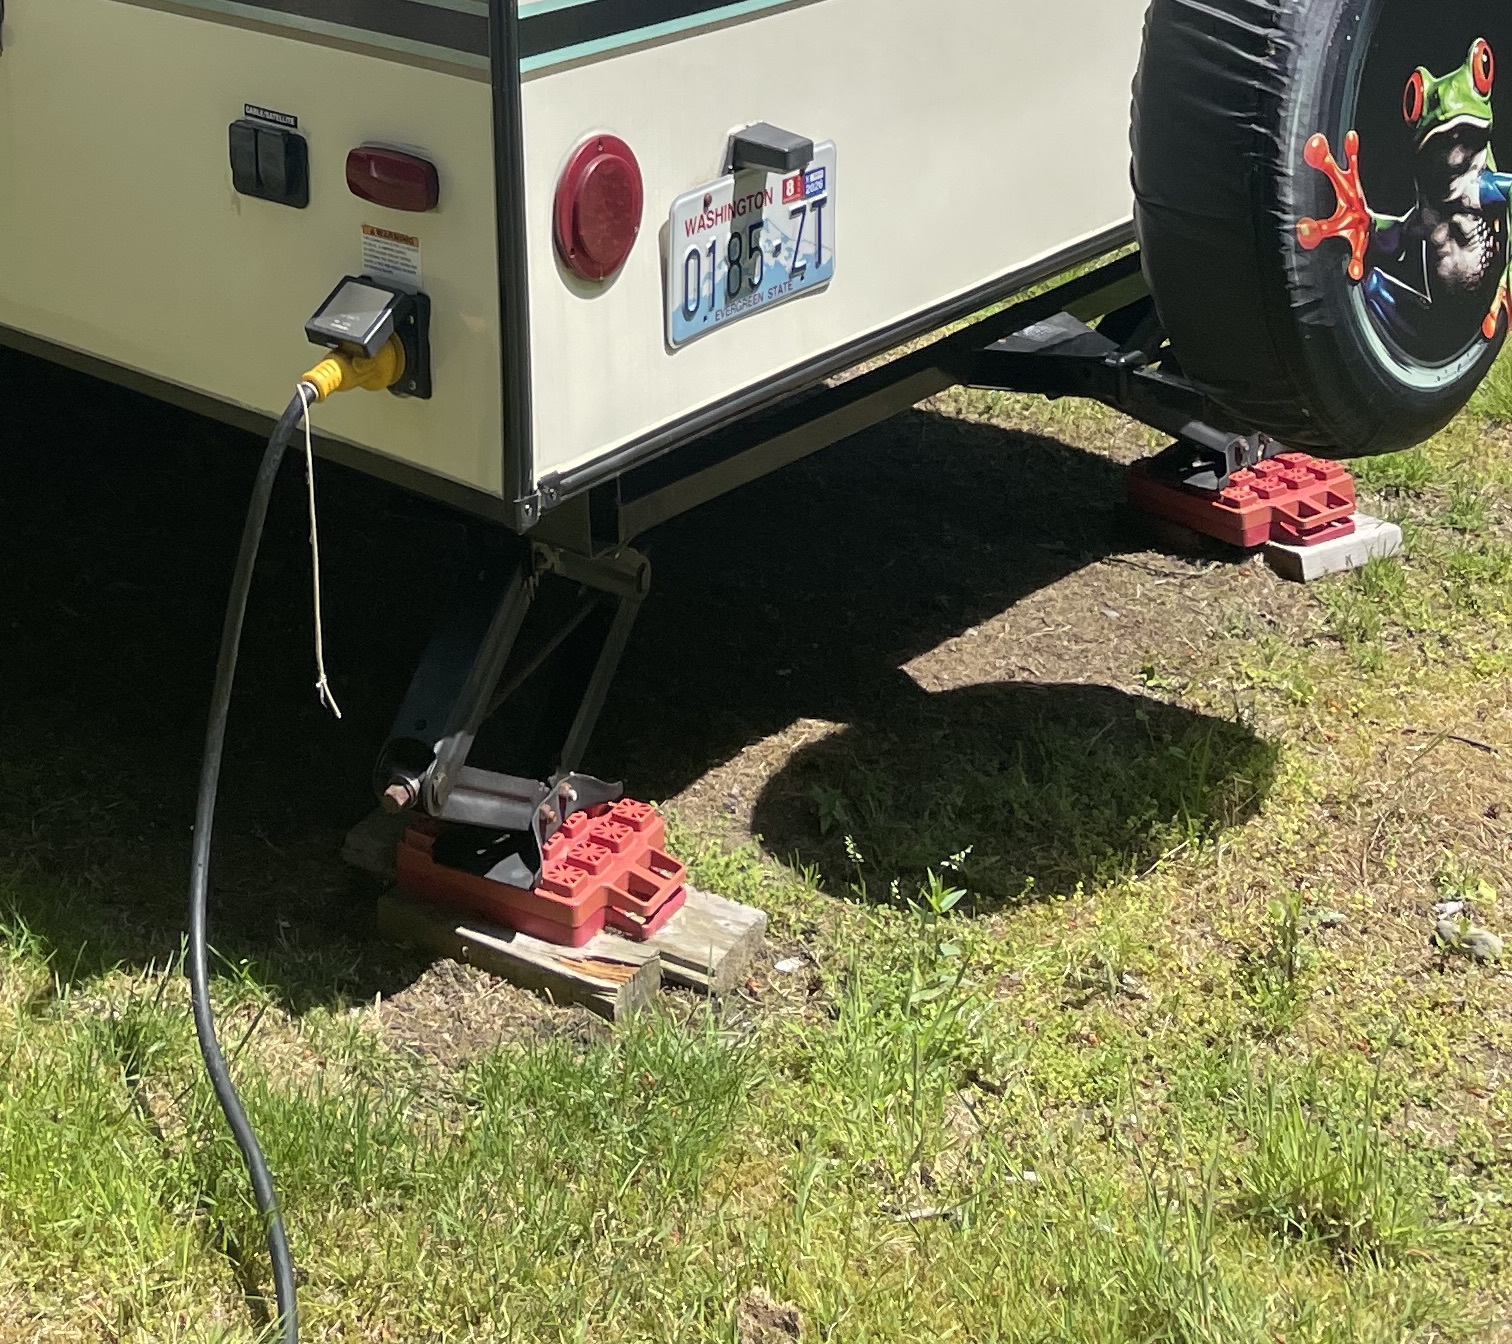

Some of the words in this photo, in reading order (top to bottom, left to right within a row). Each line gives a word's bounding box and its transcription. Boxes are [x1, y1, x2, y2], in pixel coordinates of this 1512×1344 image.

[685, 188, 774, 237] WASHINGTON
[715, 295, 764, 321] EVERGREEN
[767, 281, 794, 299] STATE
